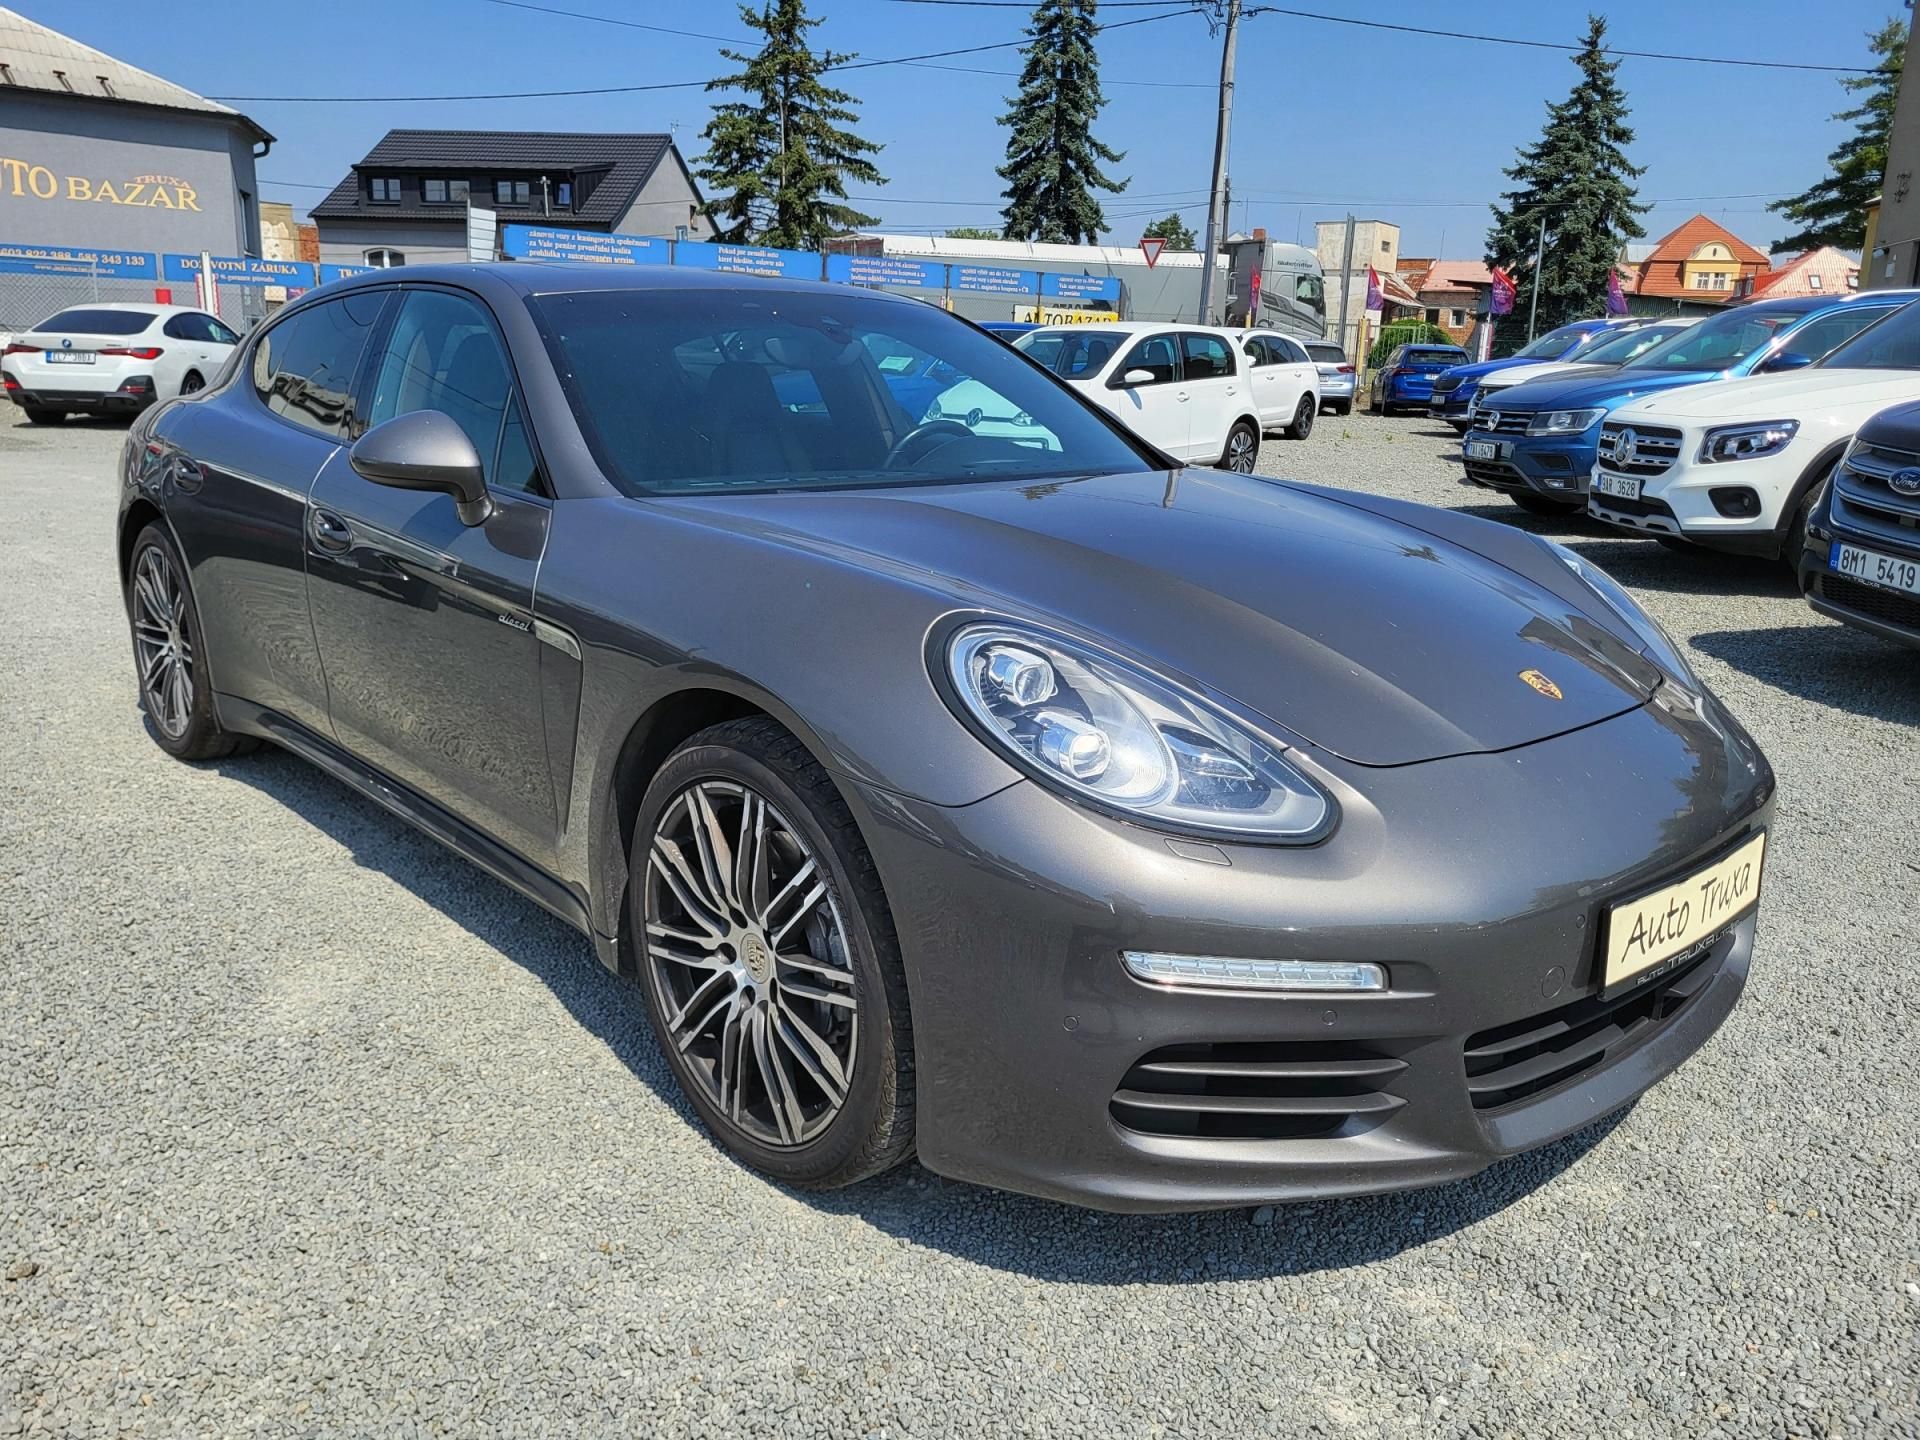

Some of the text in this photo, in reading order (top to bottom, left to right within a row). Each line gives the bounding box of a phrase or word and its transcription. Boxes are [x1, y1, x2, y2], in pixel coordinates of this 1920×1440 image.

[0, 157, 203, 211] TO BAZAR
[134, 174, 191, 189] TRUXA
[181, 259, 298, 275] DOVOTNÍ ZÁRUKA
[1617, 479, 1636, 497] 3628
[1895, 473, 1920, 489] Ford
[1841, 548, 1916, 588] 8M1 5419
[498, 611, 530, 632] diesel
[1621, 862, 1751, 964] Auto Truxa
[1636, 933, 1715, 985] AUTO TRUXA
